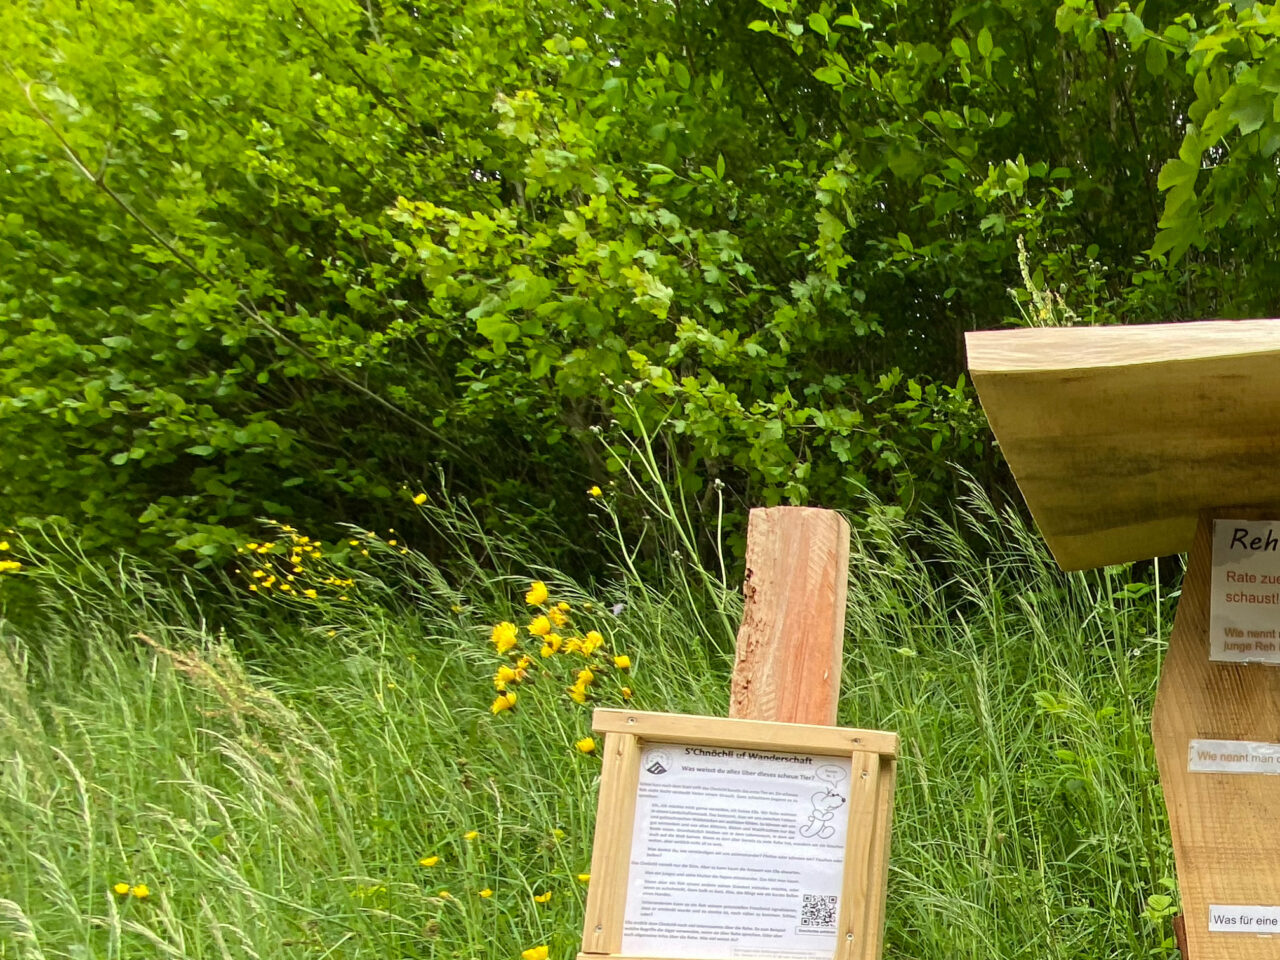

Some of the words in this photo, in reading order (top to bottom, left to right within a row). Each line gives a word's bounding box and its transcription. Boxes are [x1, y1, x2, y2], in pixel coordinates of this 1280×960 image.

[1226, 571, 1257, 584] Rate
[1225, 592, 1279, 605] schaust!
[1224, 627, 1244, 638] Wie
[1247, 629, 1276, 639] nennt
[1224, 641, 1253, 654] junge
[1255, 642, 1276, 652] Reh
[748, 752, 813, 765] Wanderschaft
[1197, 751, 1217, 763] Wie
[1220, 753, 1249, 764] nennt
[1251, 756, 1274, 764] man
[1213, 915, 1237, 925] Was
[1239, 915, 1253, 925] für
[1256, 916, 1278, 926] eine
